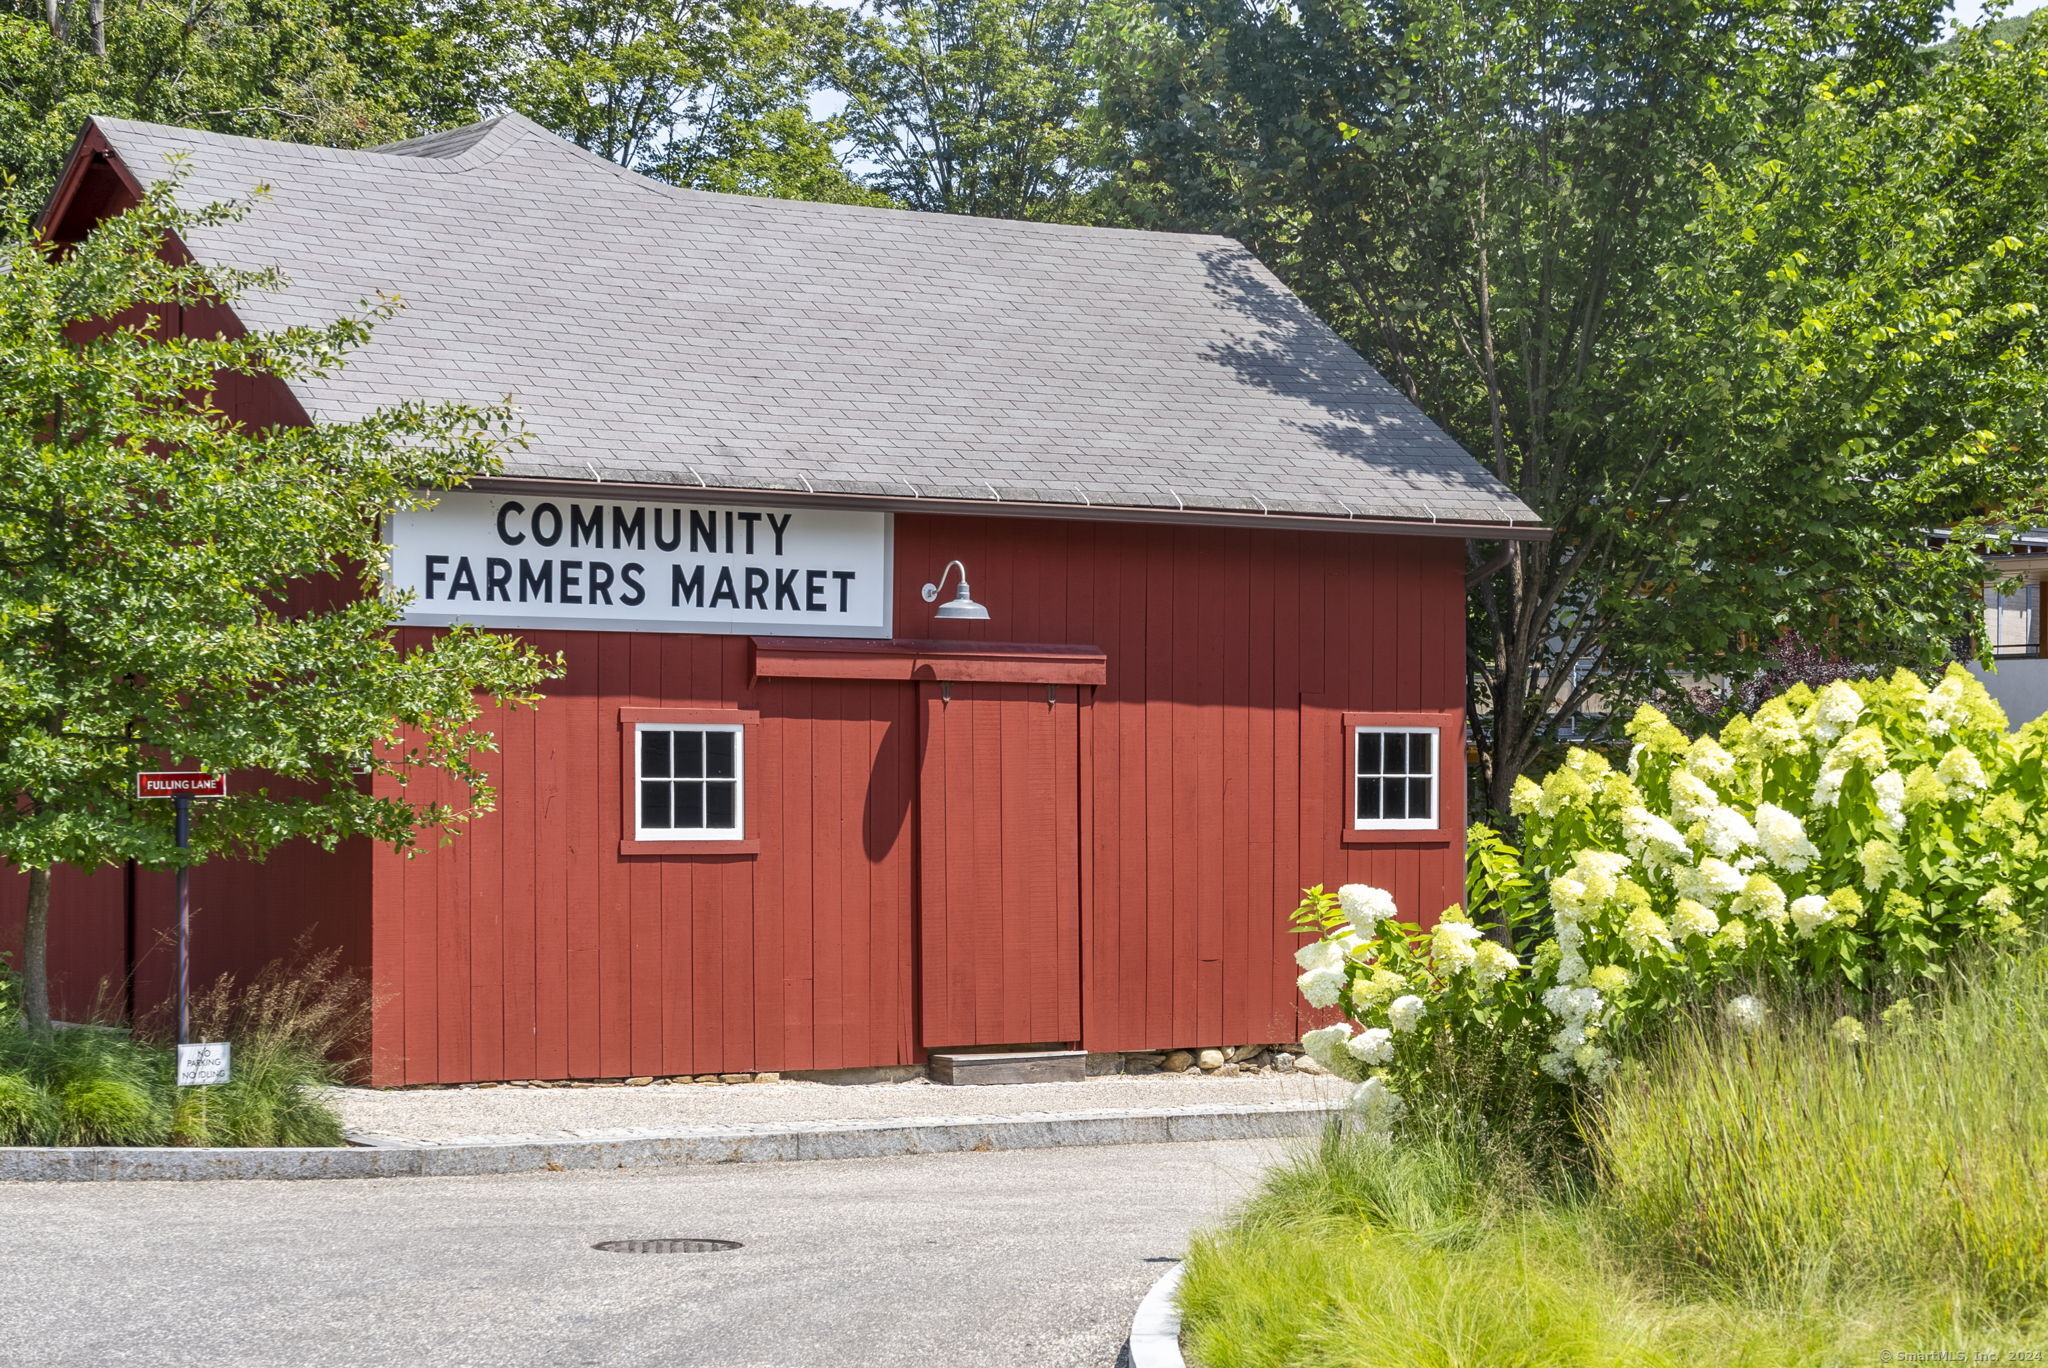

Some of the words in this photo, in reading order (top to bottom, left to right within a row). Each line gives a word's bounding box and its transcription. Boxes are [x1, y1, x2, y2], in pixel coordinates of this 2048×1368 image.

[498, 500, 793, 557] COMMUNITY
[425, 554, 646, 607] FARMERS
[671, 563, 856, 613] MARKET
[147, 780, 189, 790] FULLING
[191, 780, 217, 789] LANE
[197, 1049, 211, 1058] NO
[187, 1058, 221, 1067] PARKING
[182, 1071, 197, 1079] NO
[198, 1069, 226, 1079] IDLING
